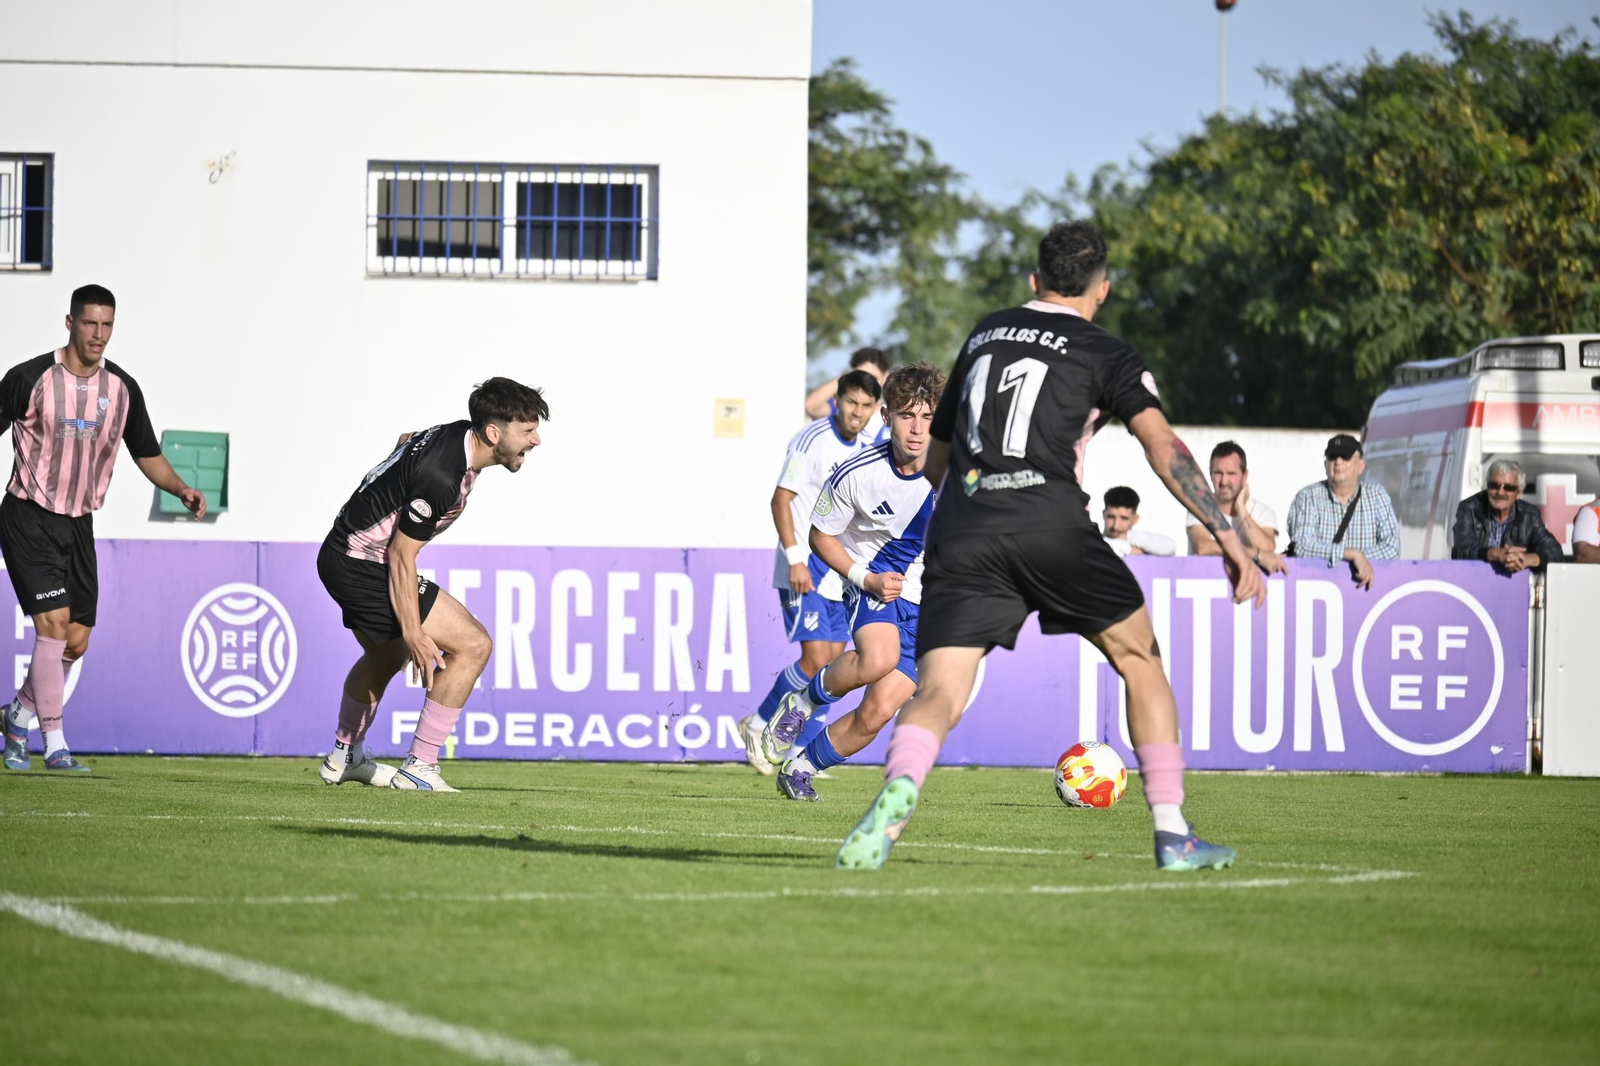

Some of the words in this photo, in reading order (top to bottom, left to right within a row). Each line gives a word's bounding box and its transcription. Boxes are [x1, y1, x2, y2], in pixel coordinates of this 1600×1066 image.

[1039, 331, 1069, 355] C.F.
[961, 353, 1049, 459] 11
[36, 588, 66, 600] GIVOVA
[221, 629, 258, 648] RF
[406, 568, 751, 693] RCERA
[1390, 624, 1470, 661] RF
[221, 652, 258, 670] EF
[1389, 675, 1469, 711] EF
[391, 703, 747, 750] FDERACIÓN
